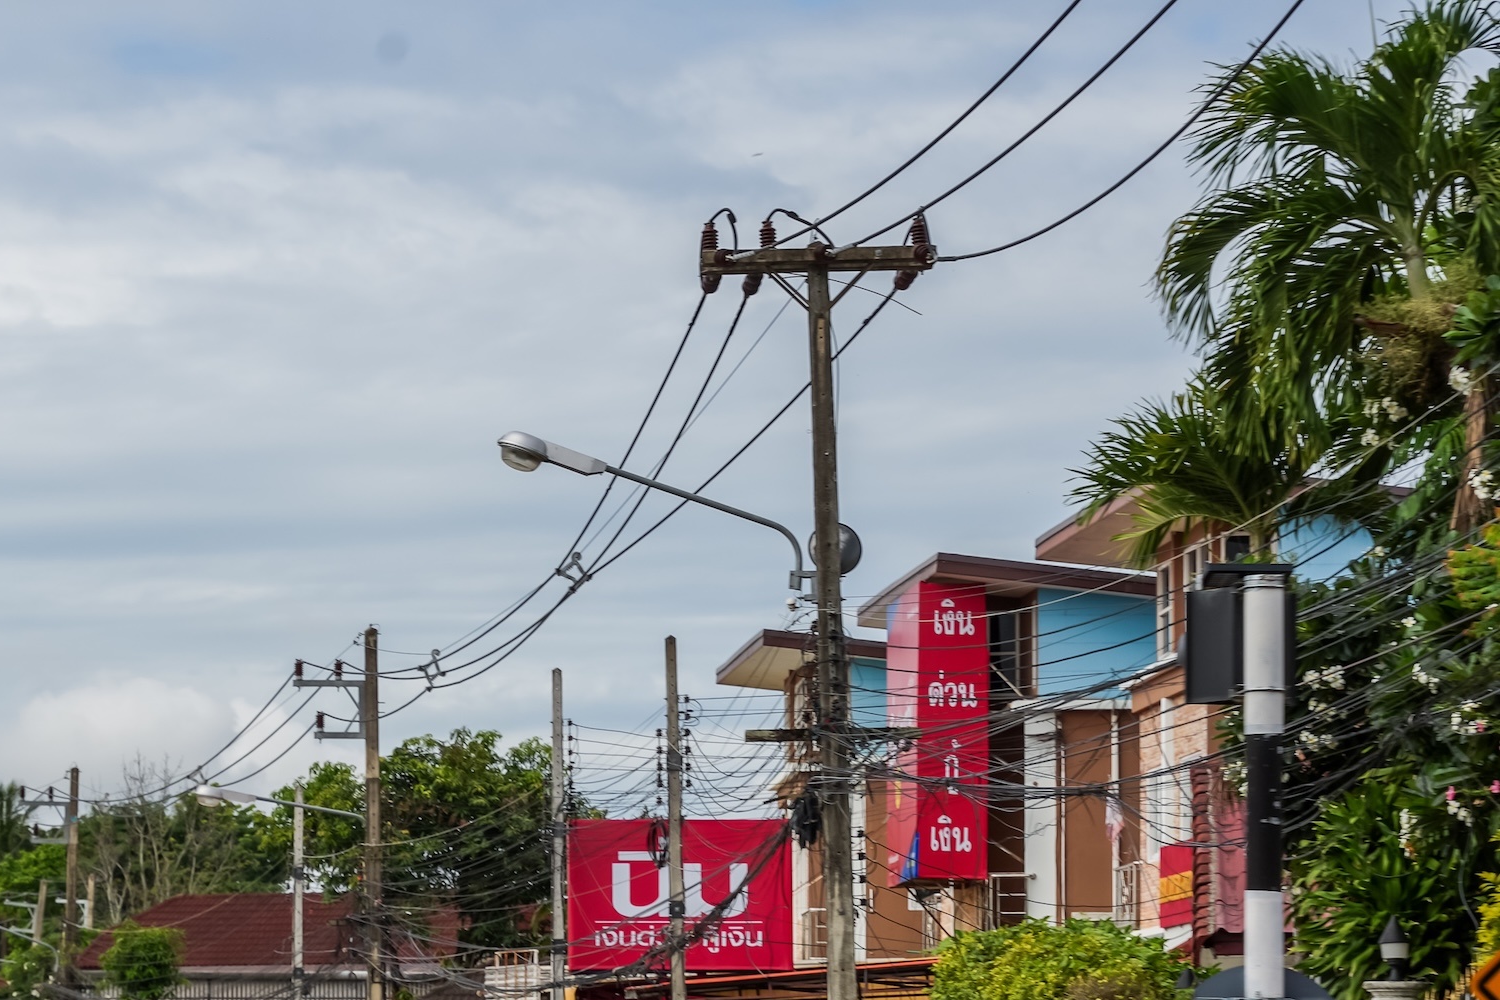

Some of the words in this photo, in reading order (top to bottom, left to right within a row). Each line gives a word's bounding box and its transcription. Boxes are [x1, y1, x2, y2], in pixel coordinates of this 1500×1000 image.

[933, 598, 975, 635] เงิน
[928, 669, 978, 708] ด่วน
[930, 814, 972, 852] เงิน
